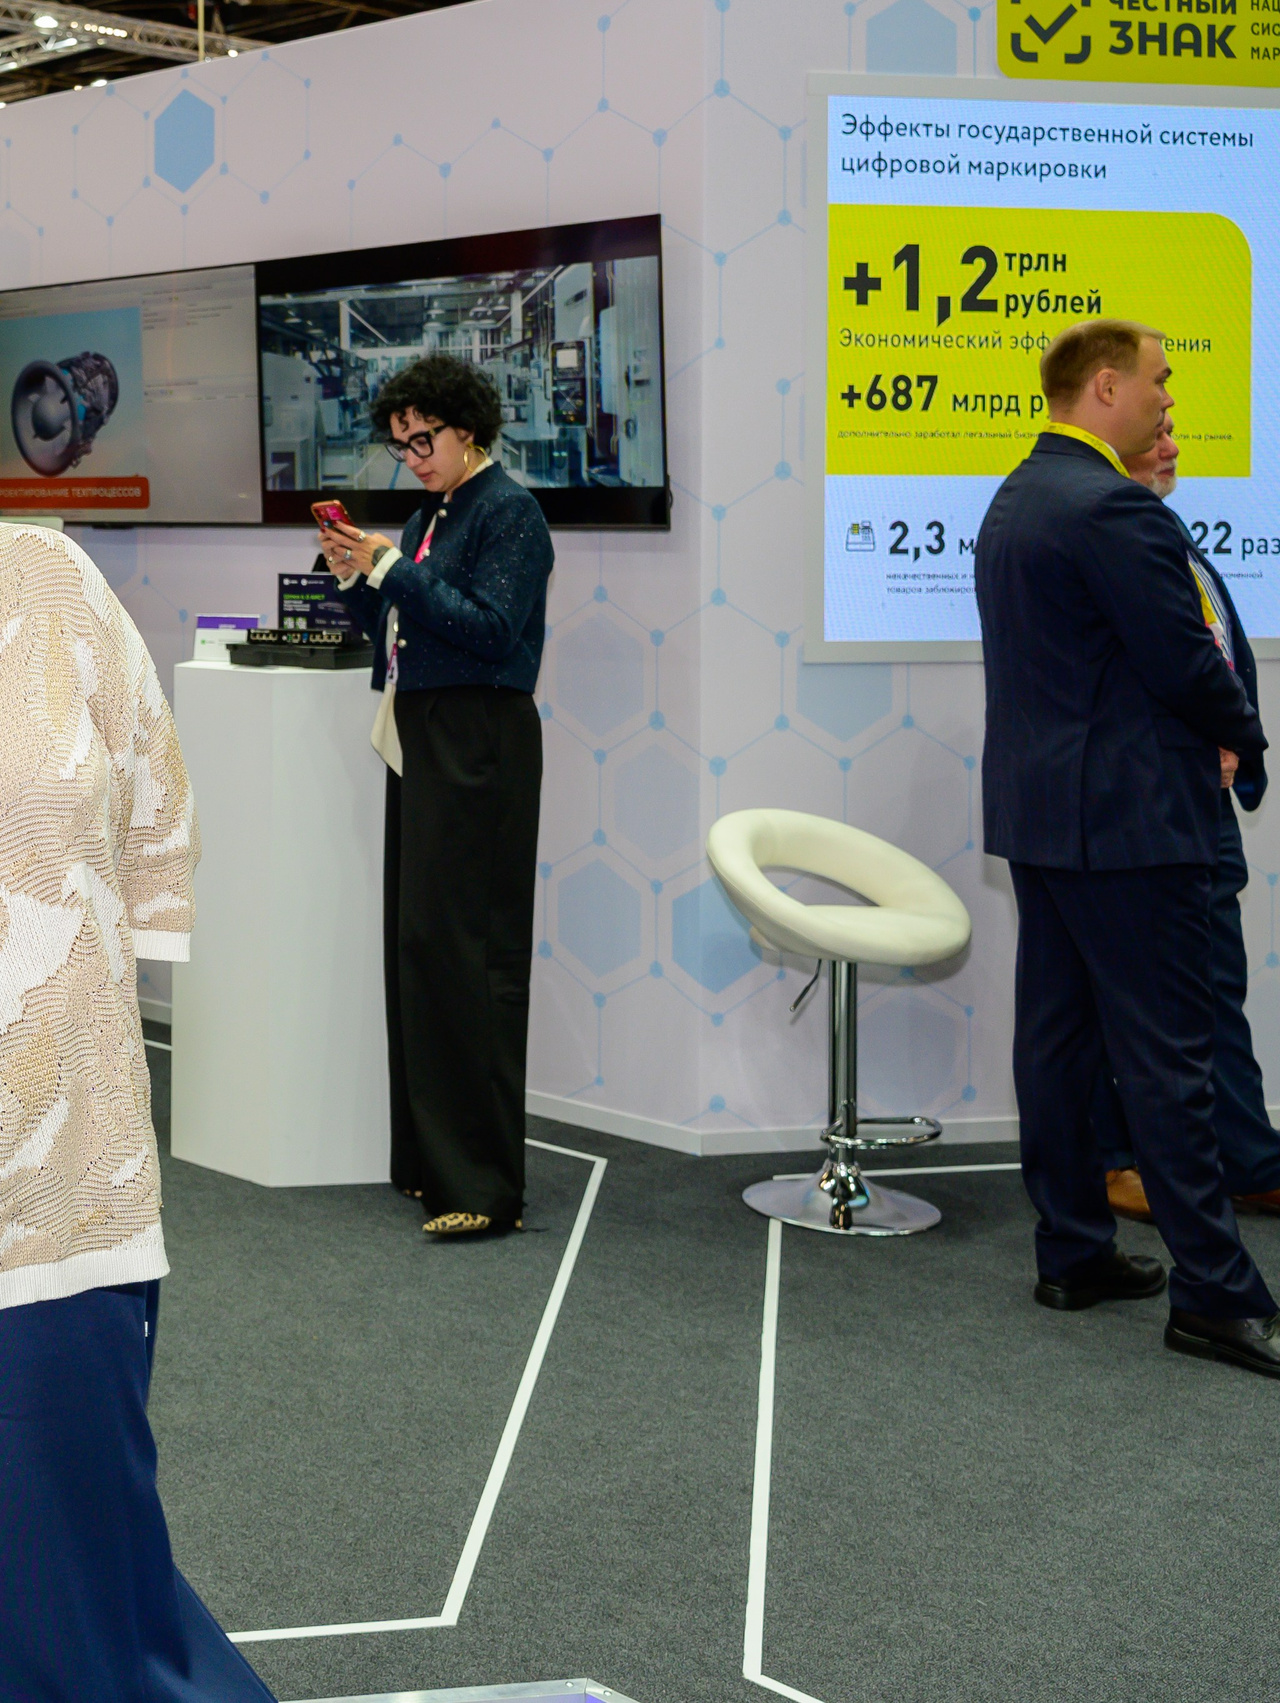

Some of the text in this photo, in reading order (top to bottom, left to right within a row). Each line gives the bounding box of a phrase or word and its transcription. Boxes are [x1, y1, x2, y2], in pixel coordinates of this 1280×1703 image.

[1109, 20, 1237, 59] ЗНАК
[841, 113, 1254, 147] Эффекты государственной системы
[841, 151, 1107, 183] цифровой маркировки
[1004, 252, 1067, 277] трлн
[843, 243, 998, 327] +1,2
[1005, 289, 1102, 318] рублей
[839, 328, 1003, 349] Экономический
[1010, 331, 1051, 354] эфф
[840, 374, 938, 411] +687
[952, 393, 1020, 418] млрд
[71, 486, 141, 498] ТЕХПРОЦЕССОВ
[889, 520, 945, 562] 2,3
